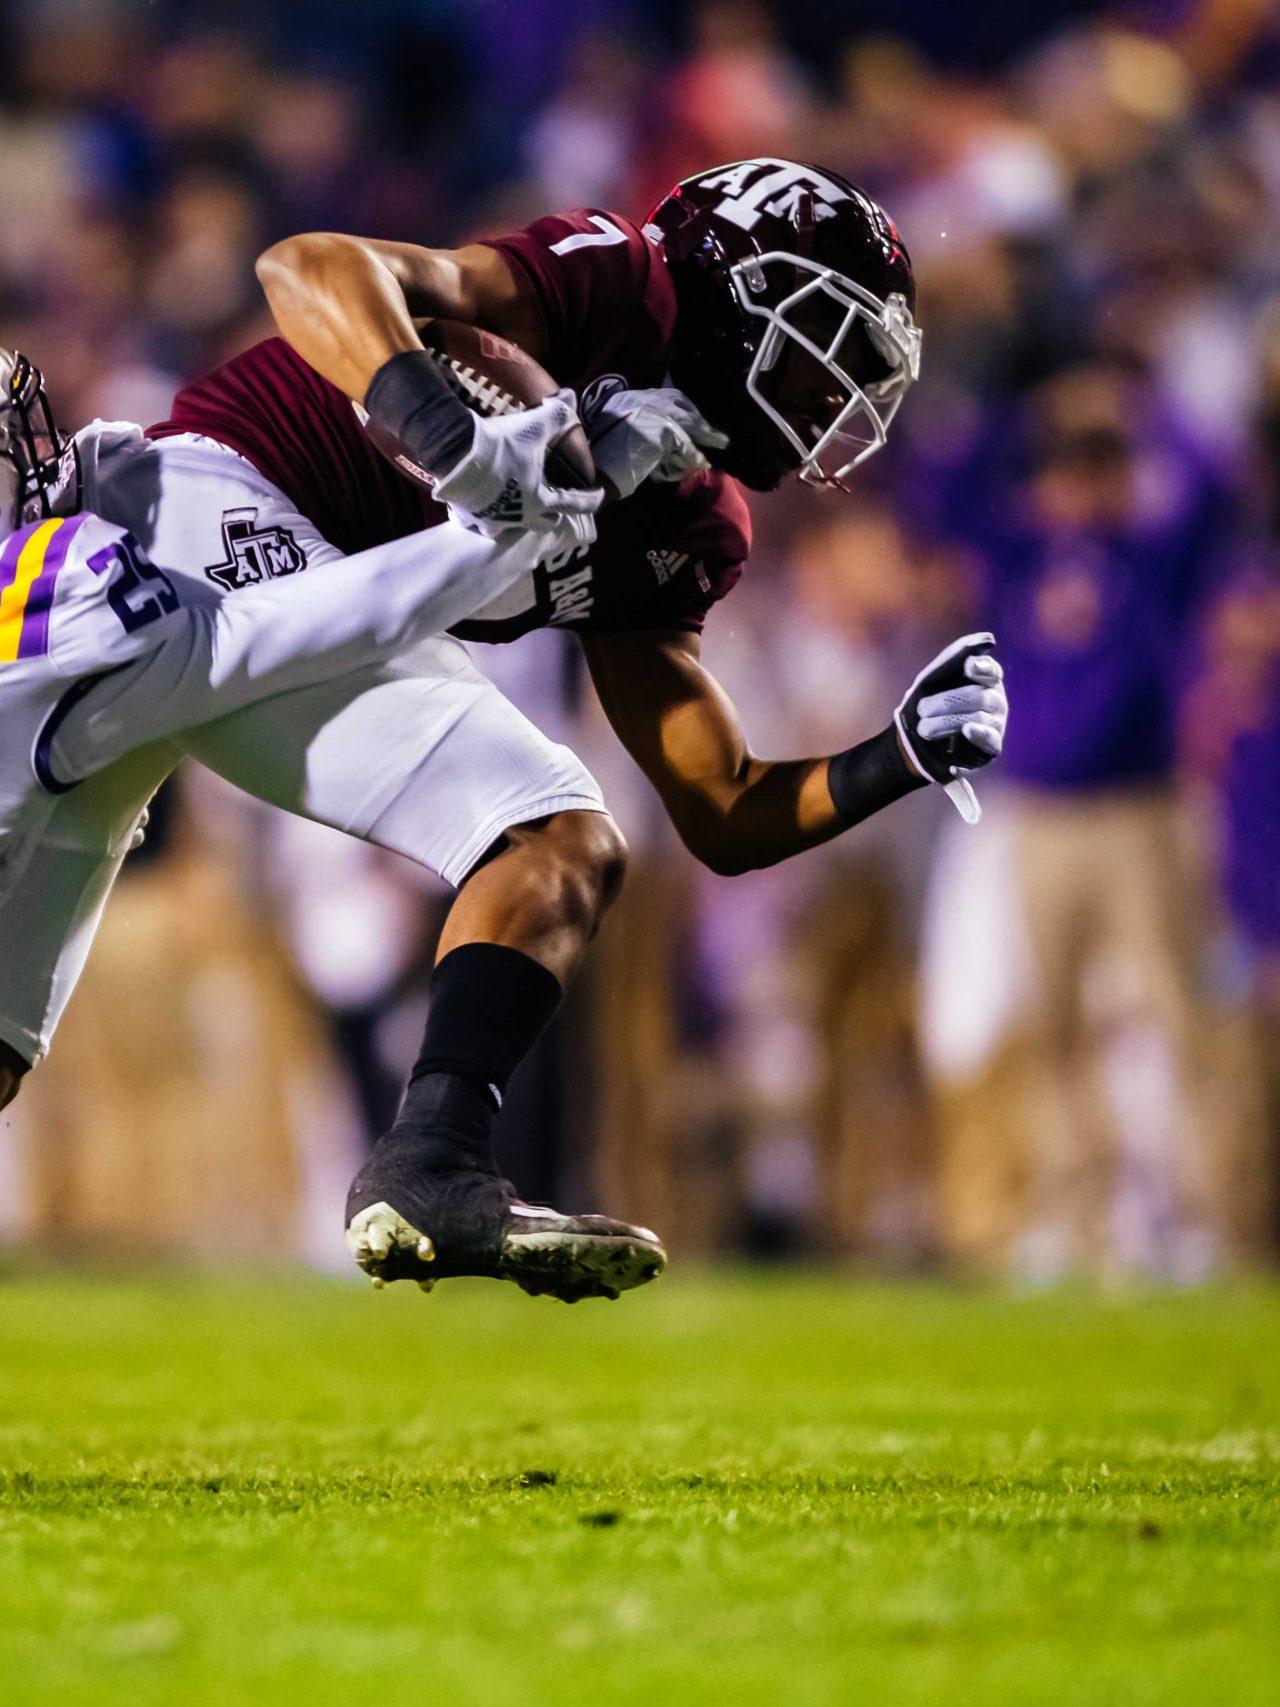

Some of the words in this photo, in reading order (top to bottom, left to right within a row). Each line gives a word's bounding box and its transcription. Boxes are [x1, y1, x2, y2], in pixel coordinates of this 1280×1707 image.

[549, 215, 629, 257] 7
[86, 530, 181, 635] 25
[547, 565, 595, 627] A&M
